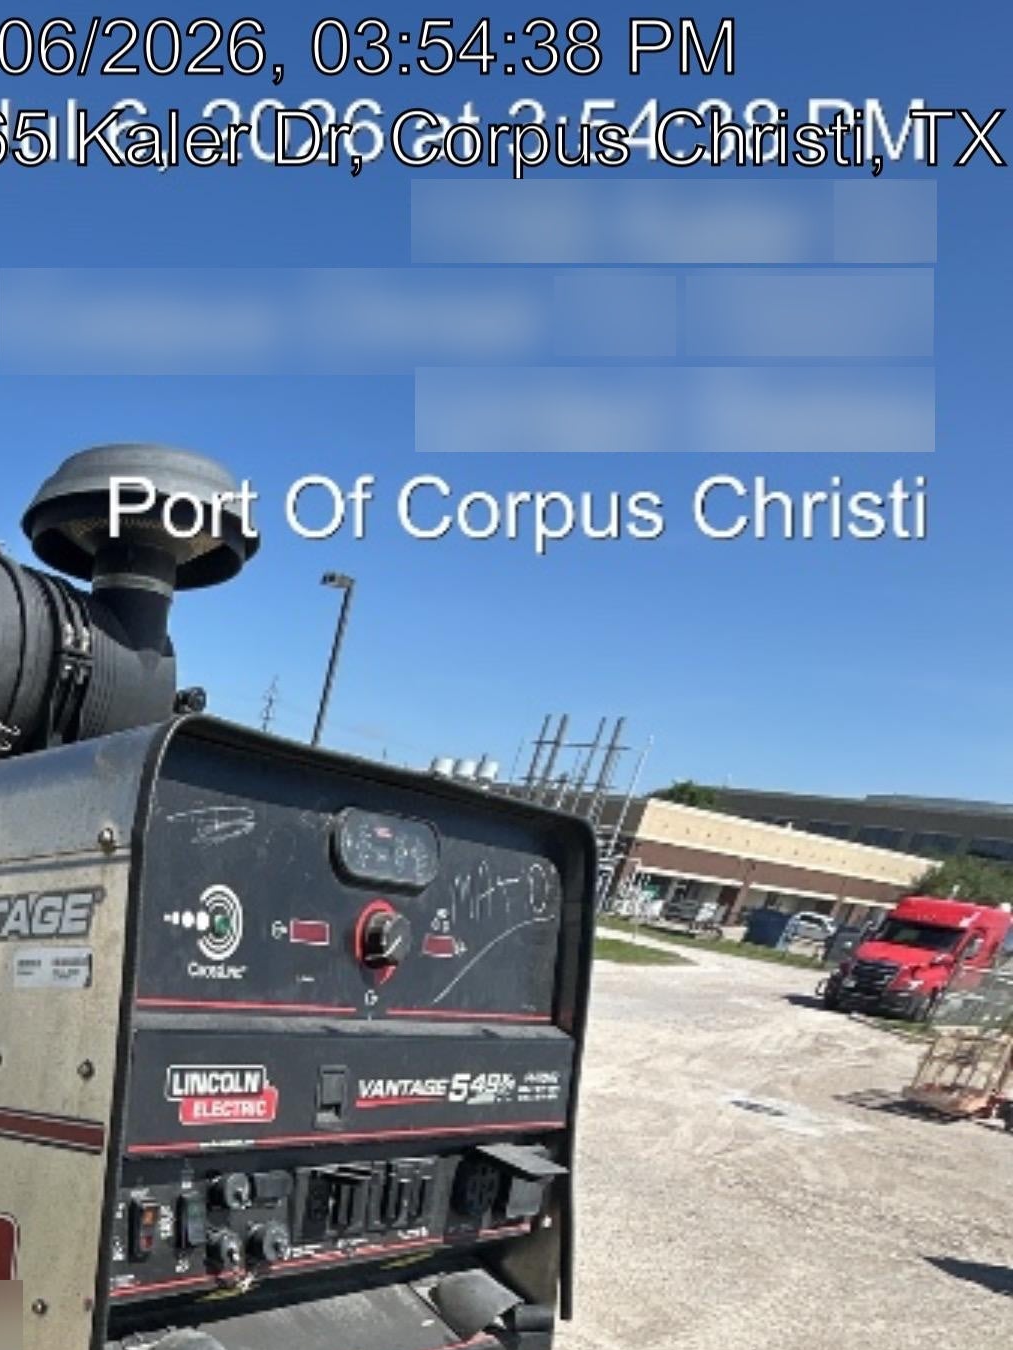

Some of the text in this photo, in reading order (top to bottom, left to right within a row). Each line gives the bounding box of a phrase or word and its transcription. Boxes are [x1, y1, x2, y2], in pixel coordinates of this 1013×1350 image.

[172, 1071, 261, 1097] LINCOLN
[358, 1077, 450, 1099] VANTAGE
[192, 1100, 267, 1118] ELECTRIC
